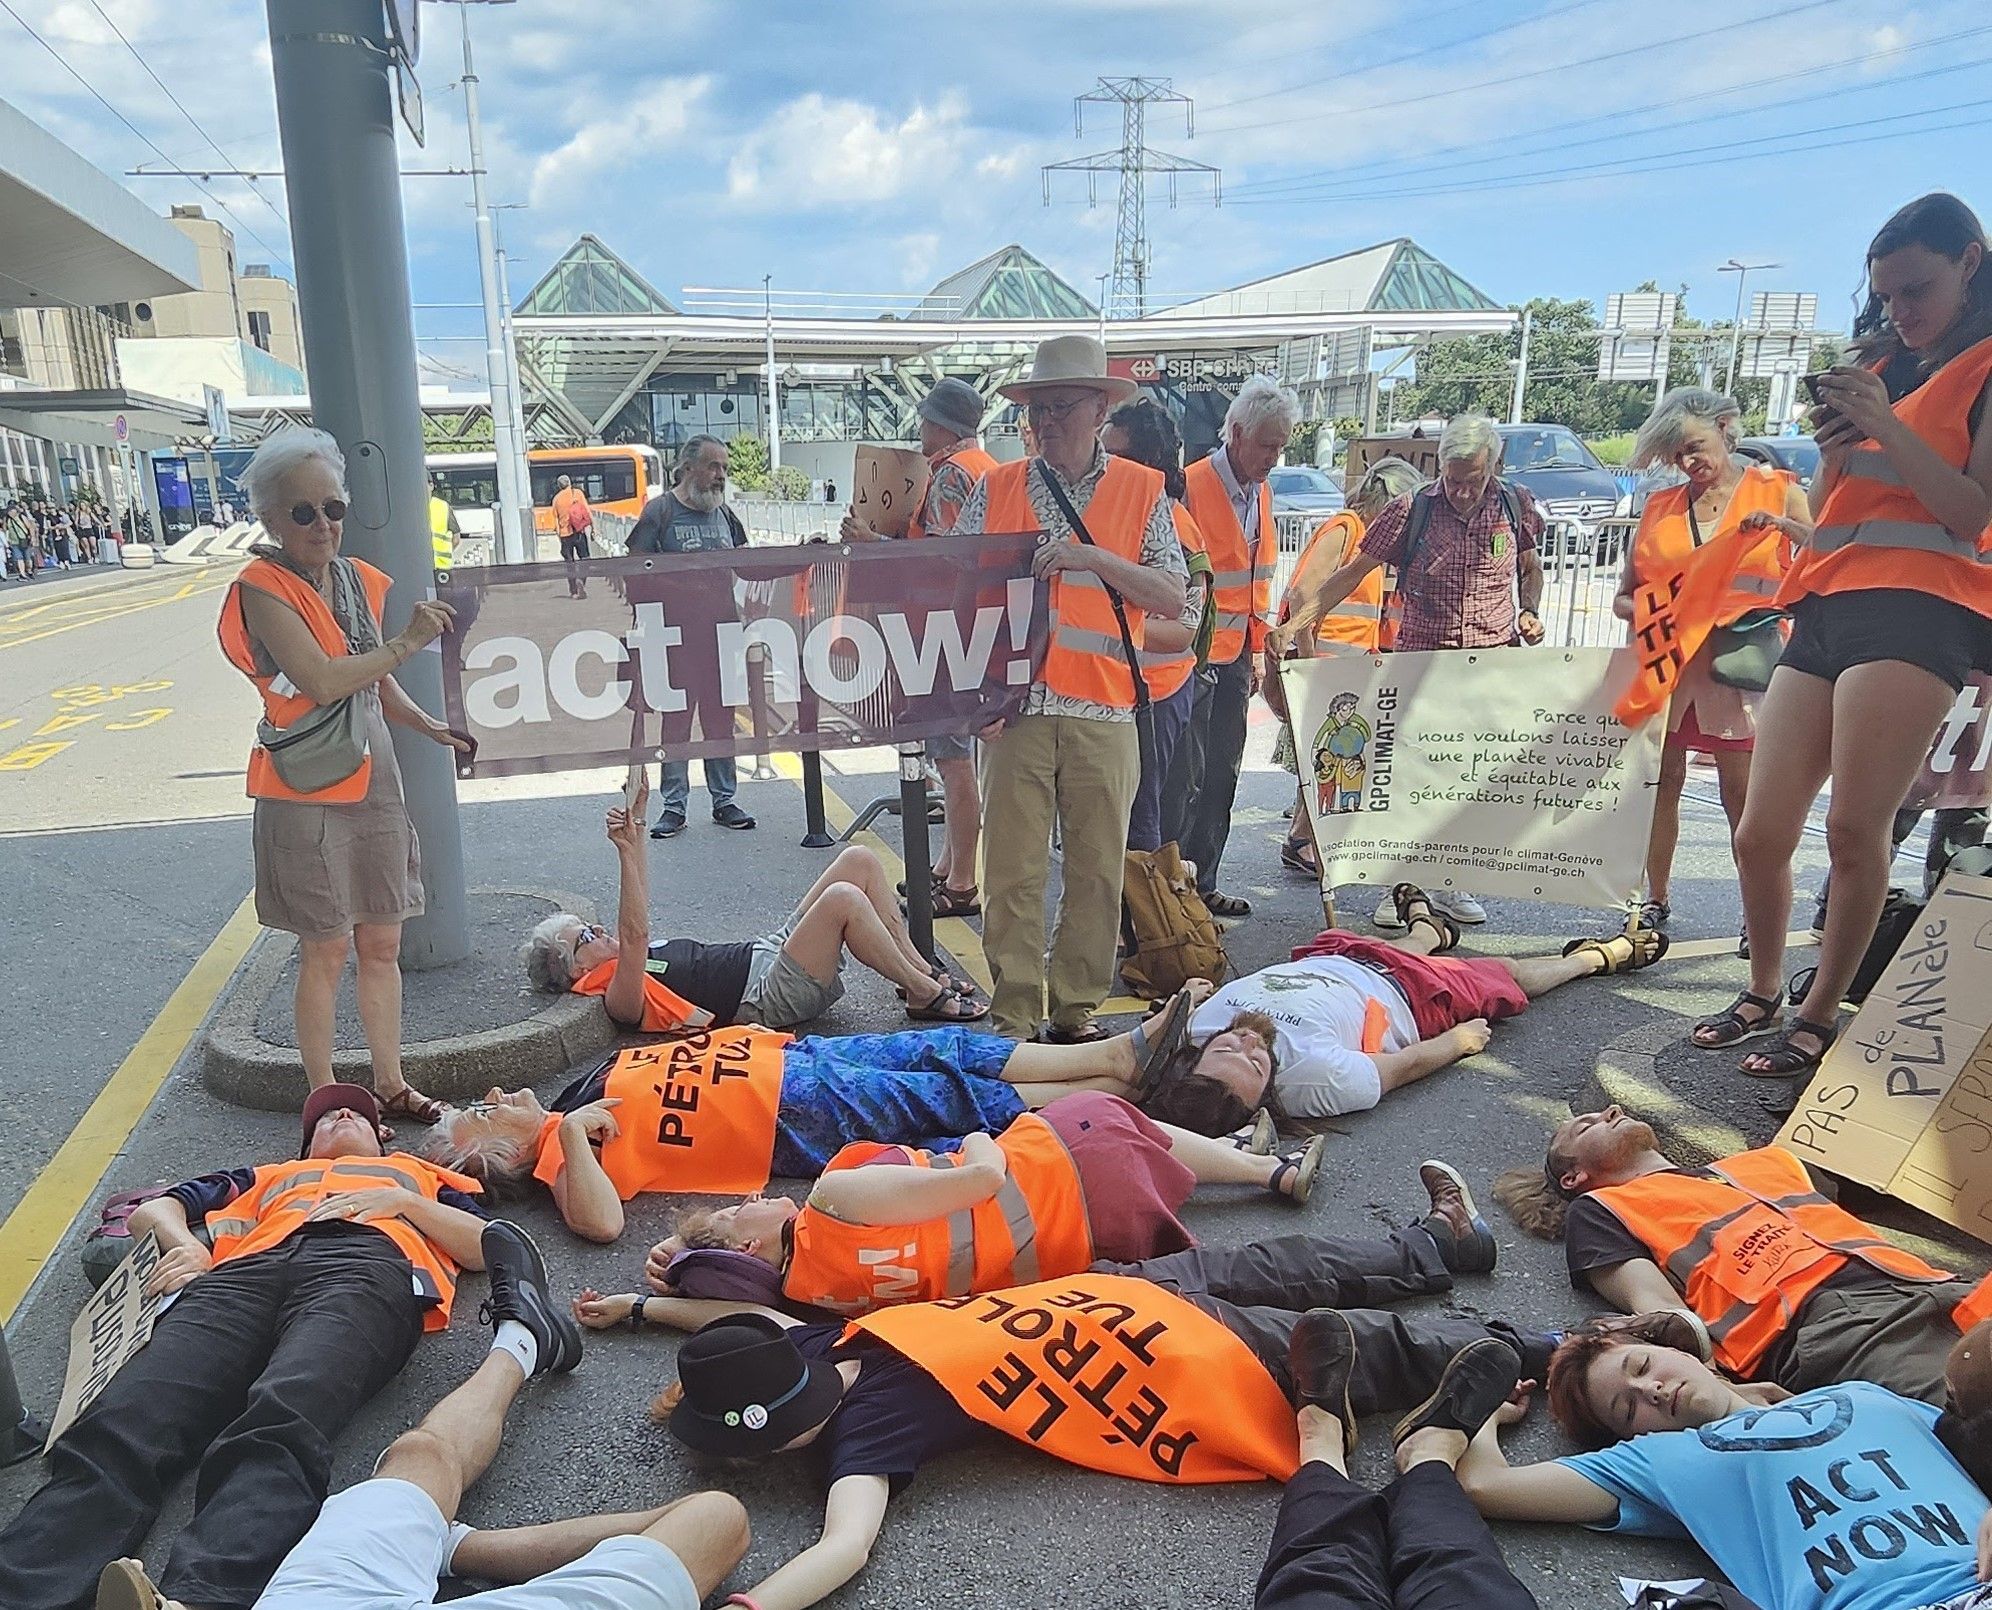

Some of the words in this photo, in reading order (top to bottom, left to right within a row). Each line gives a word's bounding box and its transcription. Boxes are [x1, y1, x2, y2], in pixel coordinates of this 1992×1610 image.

[464, 600, 687, 730] act
[716, 576, 1035, 708] now!
[1418, 732, 1465, 743] nous
[1473, 728, 1554, 744] voulons
[1562, 730, 1629, 748] laisser
[1533, 708, 1587, 725] Parce
[1596, 714, 1620, 733] qu
[1369, 687, 1398, 812] GPCLIMAT-GE
[1428, 751, 1463, 762] une
[1472, 747, 1547, 770] planète
[1555, 751, 1624, 770] vivable
[1409, 784, 1524, 805] générations
[1533, 788, 1603, 811] futures
[1612, 796, 1618, 812] !
[1460, 768, 1478, 783] et
[1487, 767, 1577, 791] équitable
[1586, 779, 1621, 791] aux
[1378, 838, 1469, 854] Grands-parents
[1472, 846, 1501, 856] pour
[1503, 847, 1514, 857] le
[1517, 848, 1603, 866] climat-Genève
[1791, 1084, 1860, 1154] PAS
[1855, 1030, 1896, 1064] de
[1901, 1163, 1968, 1207] IL
[1732, 1222, 1776, 1261] SIGNEZ
[1736, 1259, 1755, 1276] LE
[1041, 1290, 1168, 1367] TUE
[976, 1351, 1068, 1443] LE
[1786, 1449, 1911, 1530] ACT
[1803, 1502, 1971, 1594] NOW
